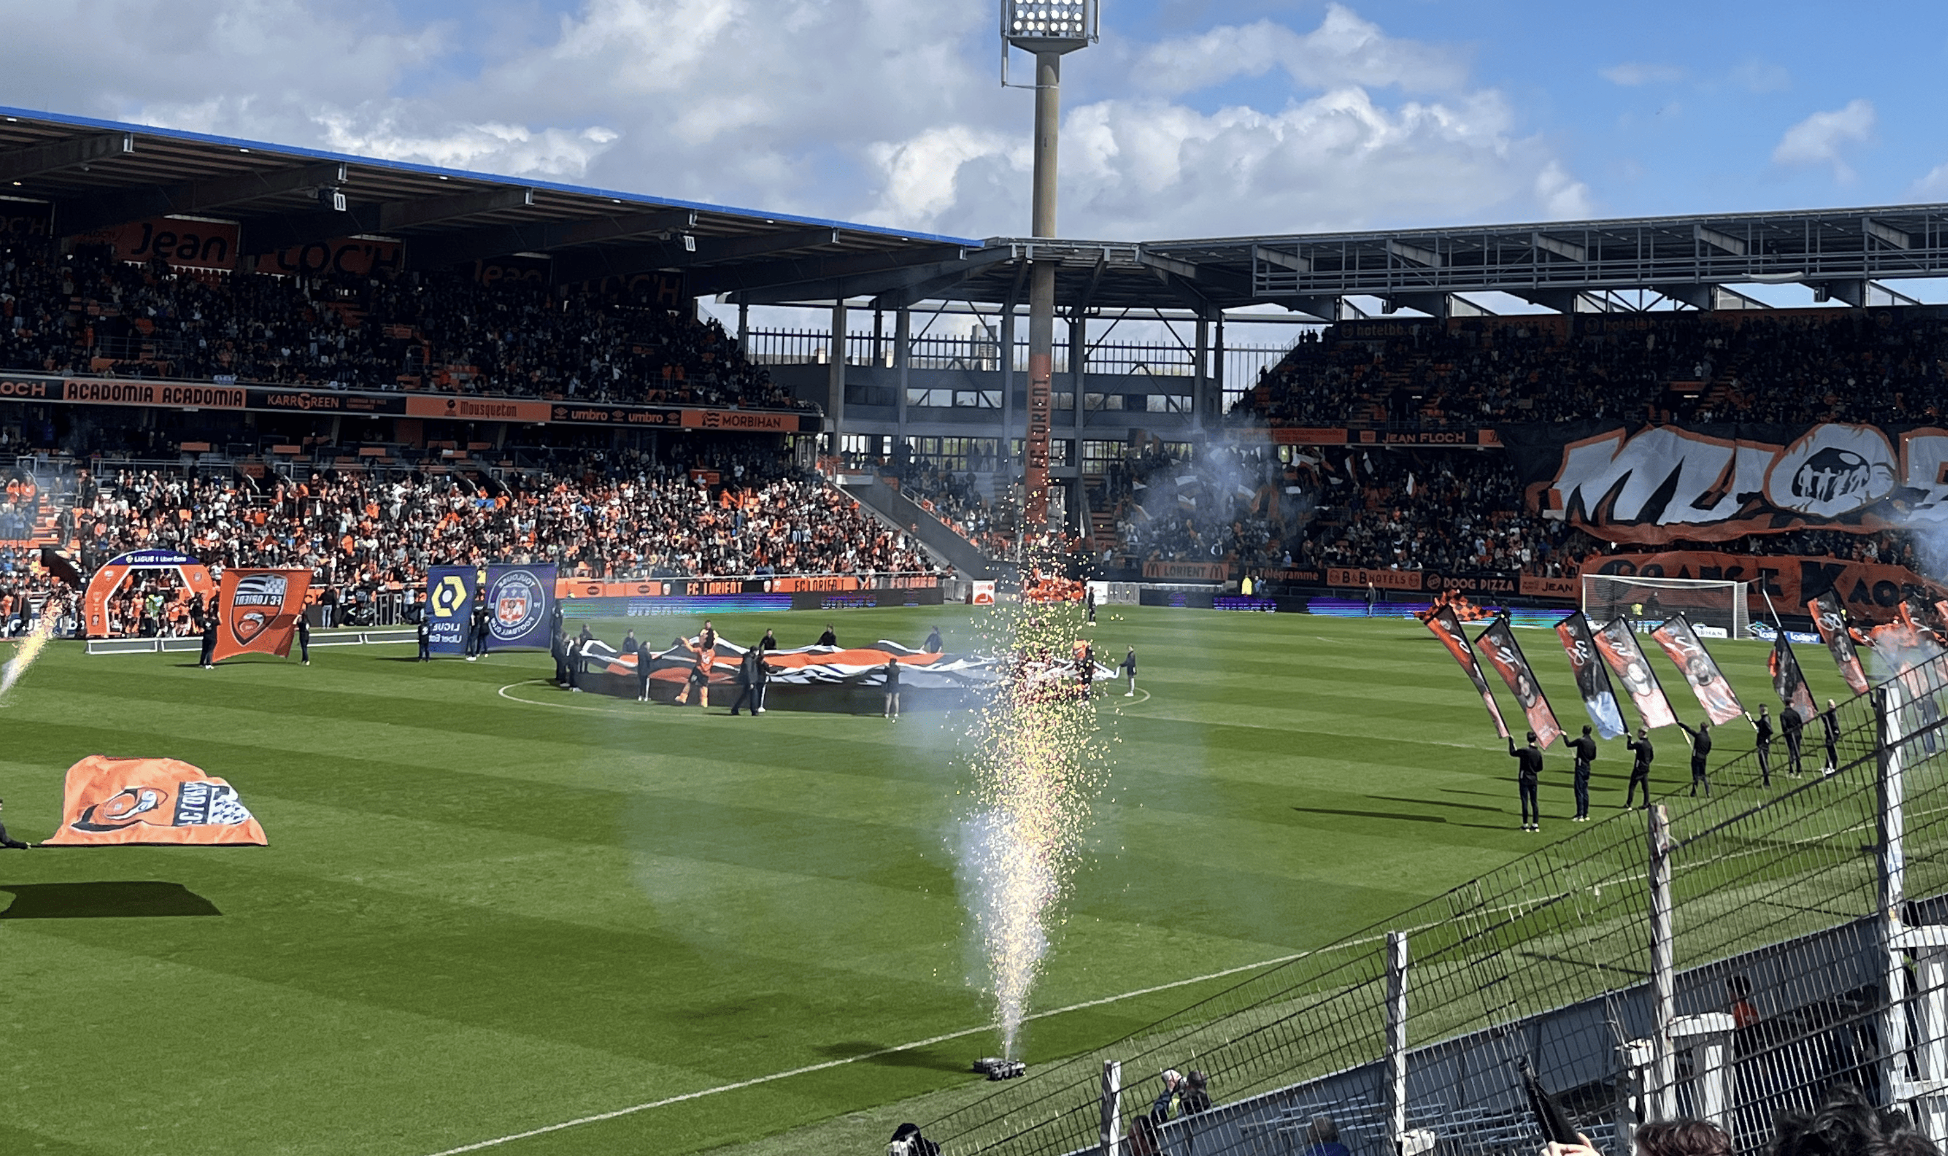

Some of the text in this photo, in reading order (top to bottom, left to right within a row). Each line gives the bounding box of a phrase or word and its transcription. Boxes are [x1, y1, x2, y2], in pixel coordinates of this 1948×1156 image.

[131, 222, 228, 262] Jean
[254, 241, 400, 277] LOC'H
[67, 382, 243, 407] ACADOMIA ACADOMIA
[460, 401, 517, 418] Mousqueton
[571, 409, 664, 423] umbro umbro
[1031, 378, 1048, 444] LORIENT
[722, 415, 782, 428] MORBIHAN
[1382, 432, 1416, 444] JEAN
[1164, 566, 1207, 578] LORIENT
[1259, 567, 1319, 581] Télégramme
[1342, 571, 1367, 584] B&B
[1368, 573, 1406, 585] HOTELS
[1443, 577, 1476, 590] DOOG
[1480, 578, 1515, 592] PIZZA
[1542, 582, 1574, 593] JEAN
